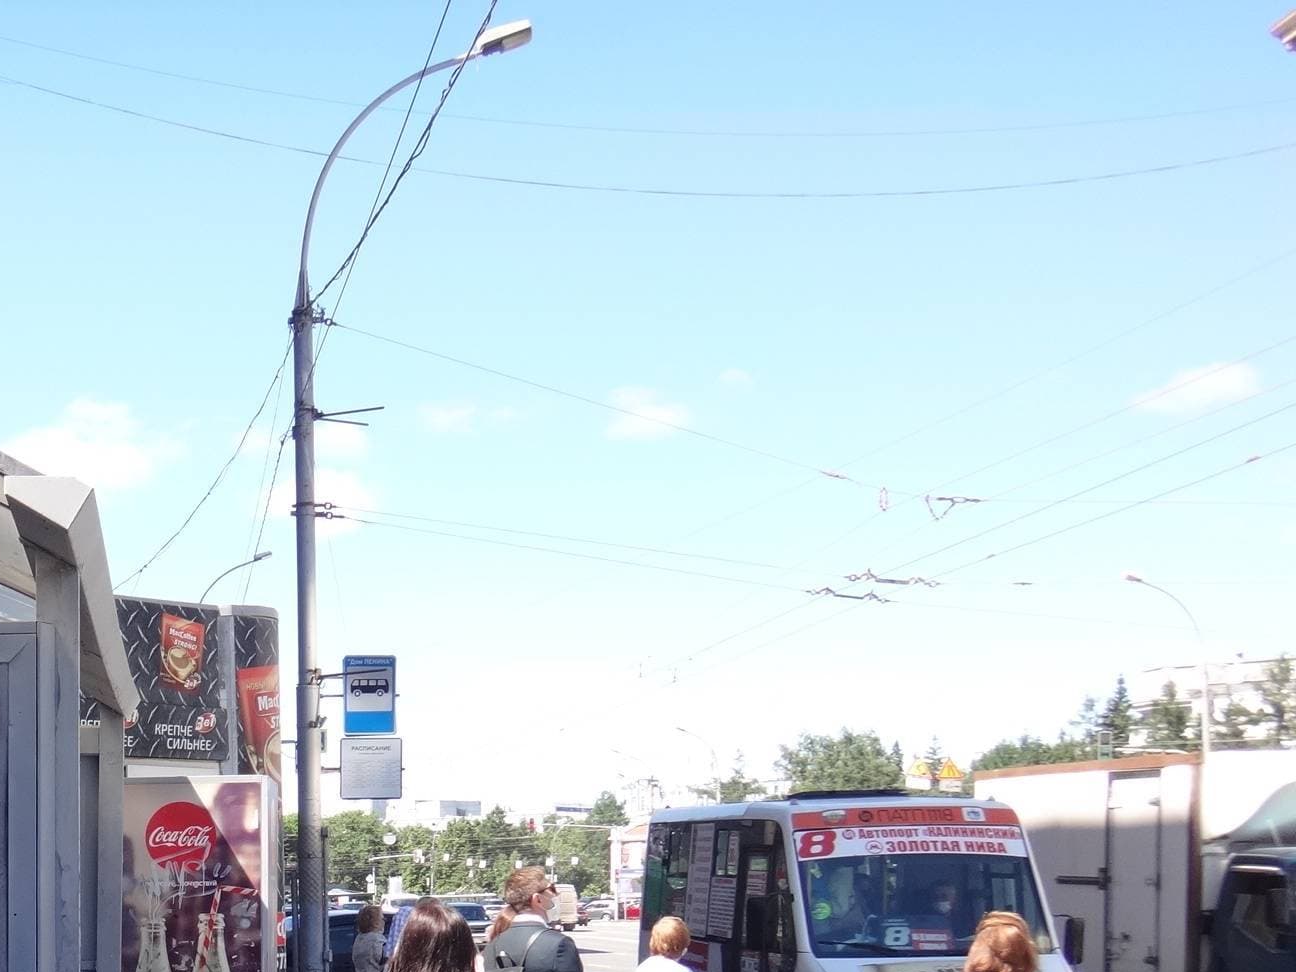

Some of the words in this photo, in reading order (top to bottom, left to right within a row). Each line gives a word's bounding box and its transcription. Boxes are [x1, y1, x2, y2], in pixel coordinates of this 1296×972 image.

[154, 723, 193, 737] КРЕПЧЕ
[166, 737, 212, 751] СИЛЬНЕЕ
[148, 825, 214, 848] Coca-Cola
[858, 828, 919, 841] Автопорт
[798, 830, 836, 859] 8
[886, 840, 960, 853] ЗОЛОТАЯ
[965, 840, 1007, 854] НИВА
[884, 926, 910, 946] 8
